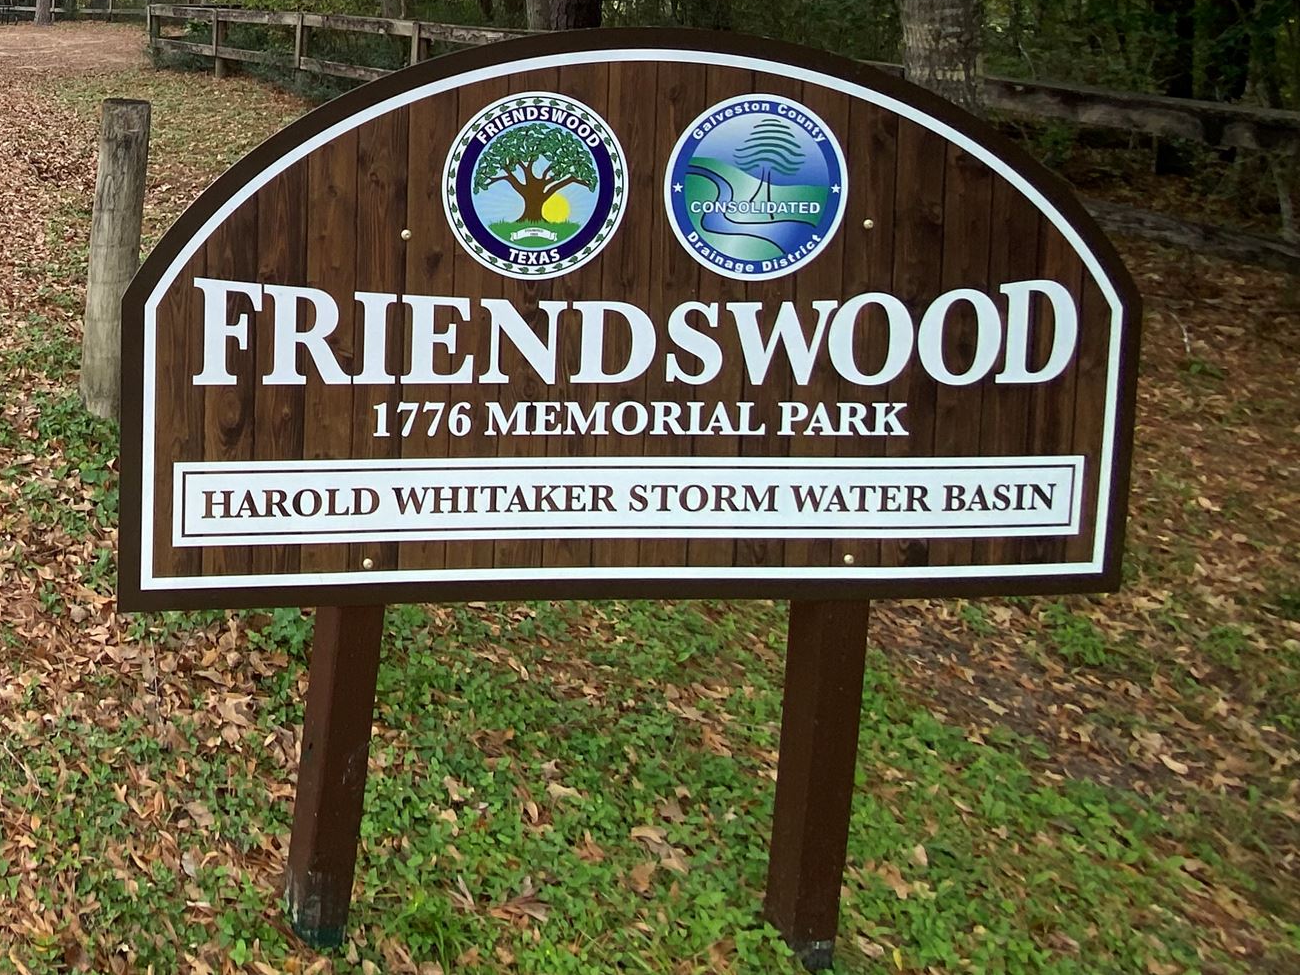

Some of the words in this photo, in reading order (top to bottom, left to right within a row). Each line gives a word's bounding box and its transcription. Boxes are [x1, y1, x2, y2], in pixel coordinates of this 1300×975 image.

[475, 106, 601, 148] FRIENDSWOOD
[692, 101, 771, 141] Galveston
[777, 103, 827, 143] County
[690, 201, 821, 214] CONSOLIDATED
[508, 248, 561, 265] TEXAS
[687, 231, 755, 273] Drainage
[762, 233, 822, 272] District
[192, 277, 1078, 386] FRIENDSWOOD
[373, 401, 472, 437] 1776
[485, 401, 765, 436] MEMORIAL
[777, 402, 909, 437] PARK
[201, 487, 380, 519] HAROLD
[392, 484, 616, 515] WHITAKER
[628, 484, 779, 513] STORM
[791, 484, 930, 513] WATER
[942, 482, 1057, 512] BASIN
